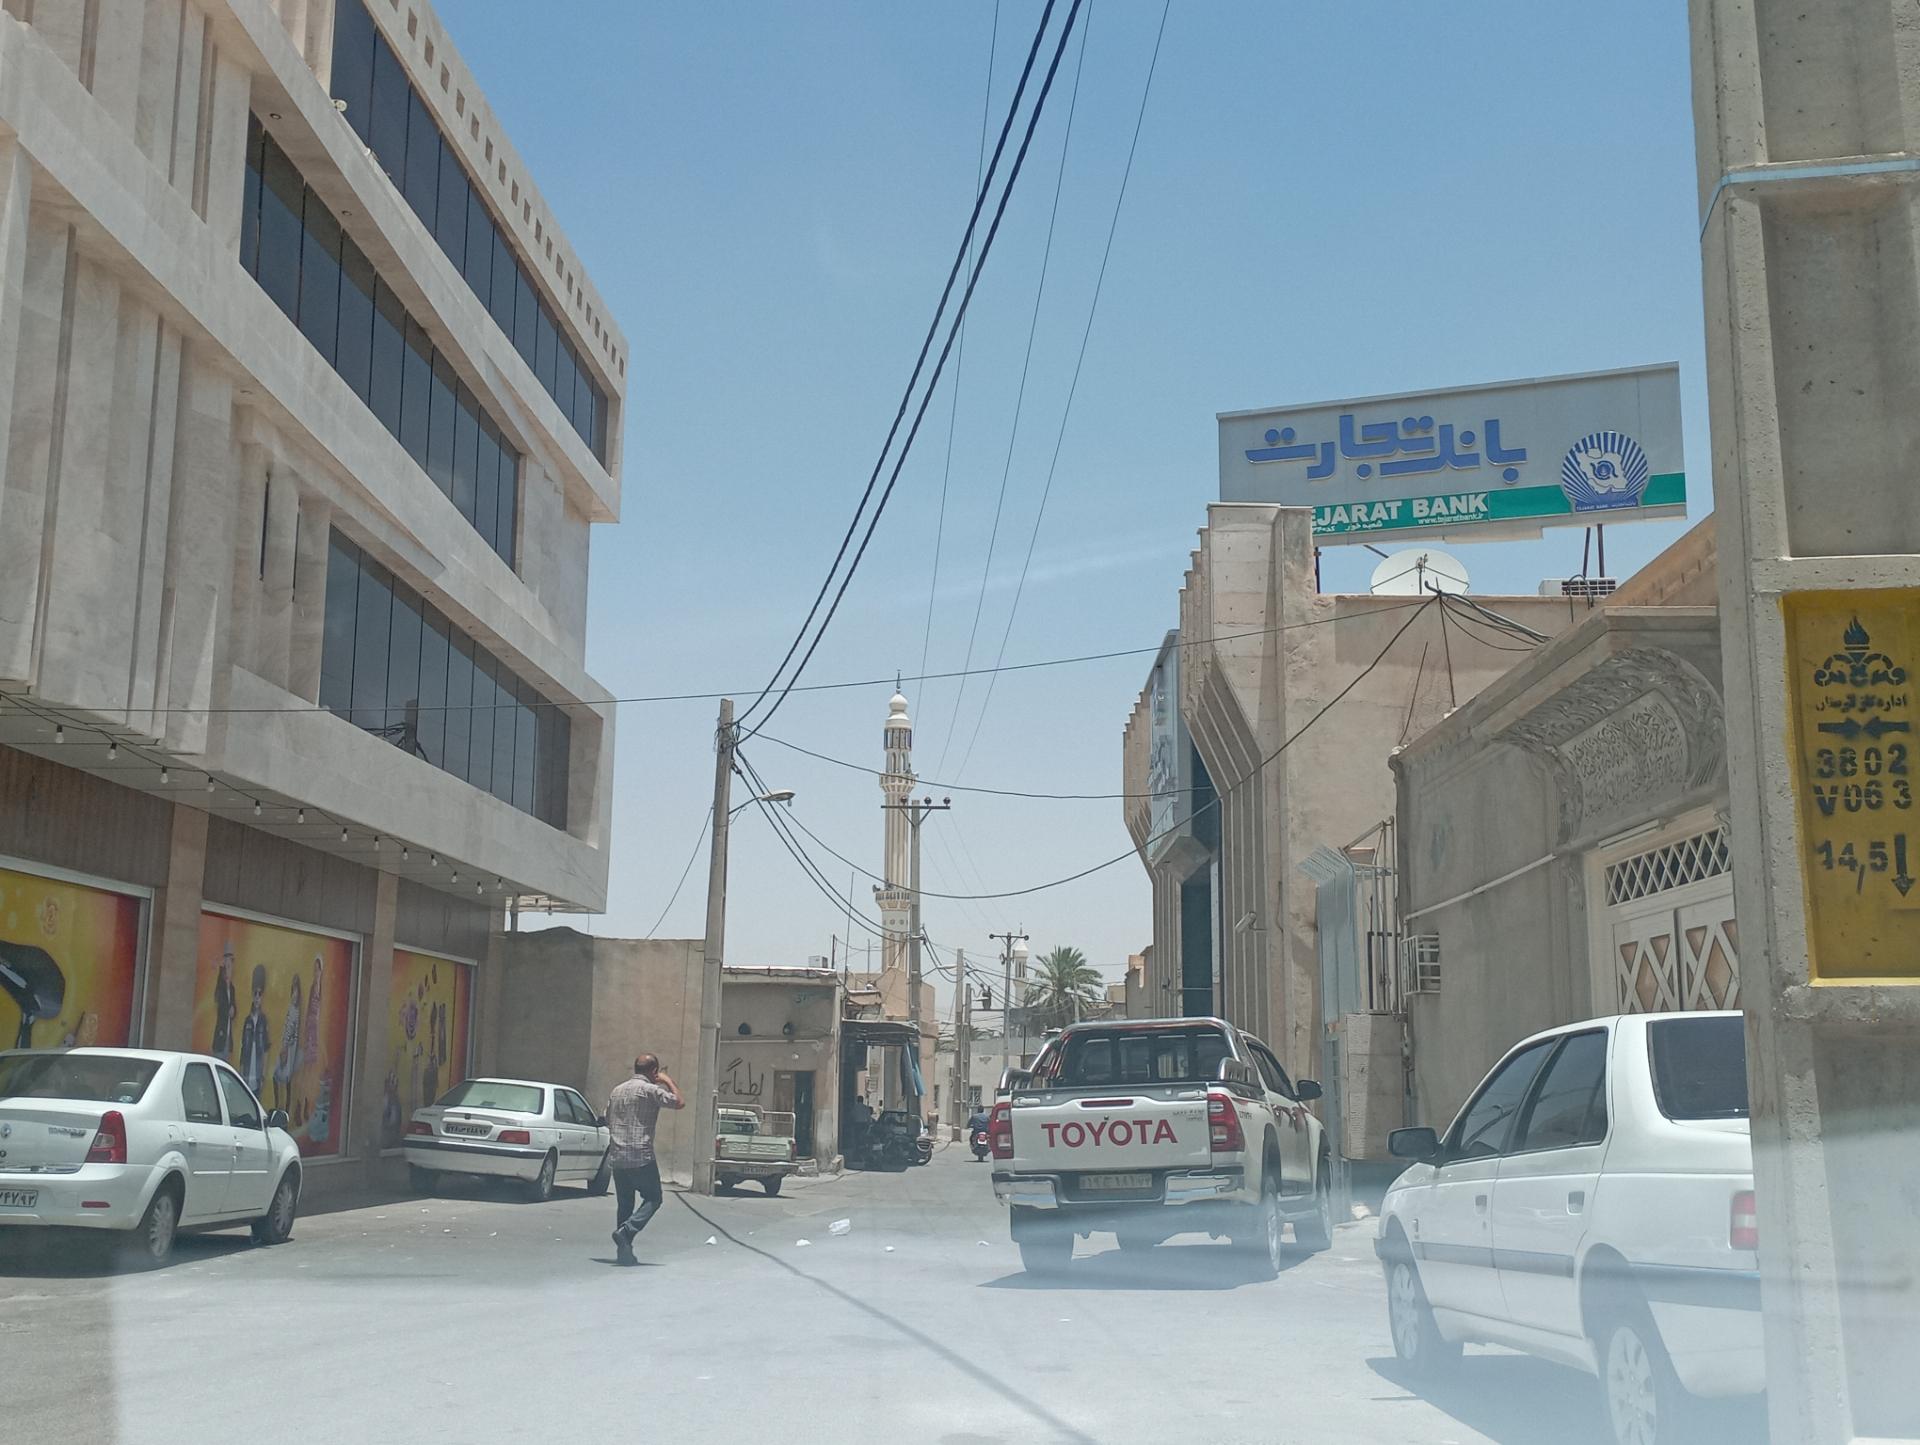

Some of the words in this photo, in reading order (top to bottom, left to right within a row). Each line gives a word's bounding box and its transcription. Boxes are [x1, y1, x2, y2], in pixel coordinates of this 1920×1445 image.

[1245, 414, 1434, 480] تجارت
[1379, 419, 1527, 484] بانک
[1412, 492, 1488, 518] BANK
[1816, 743, 1908, 778] 3802
[1813, 779, 1913, 817] V063
[1041, 1119, 1178, 1148] TOYOTA
